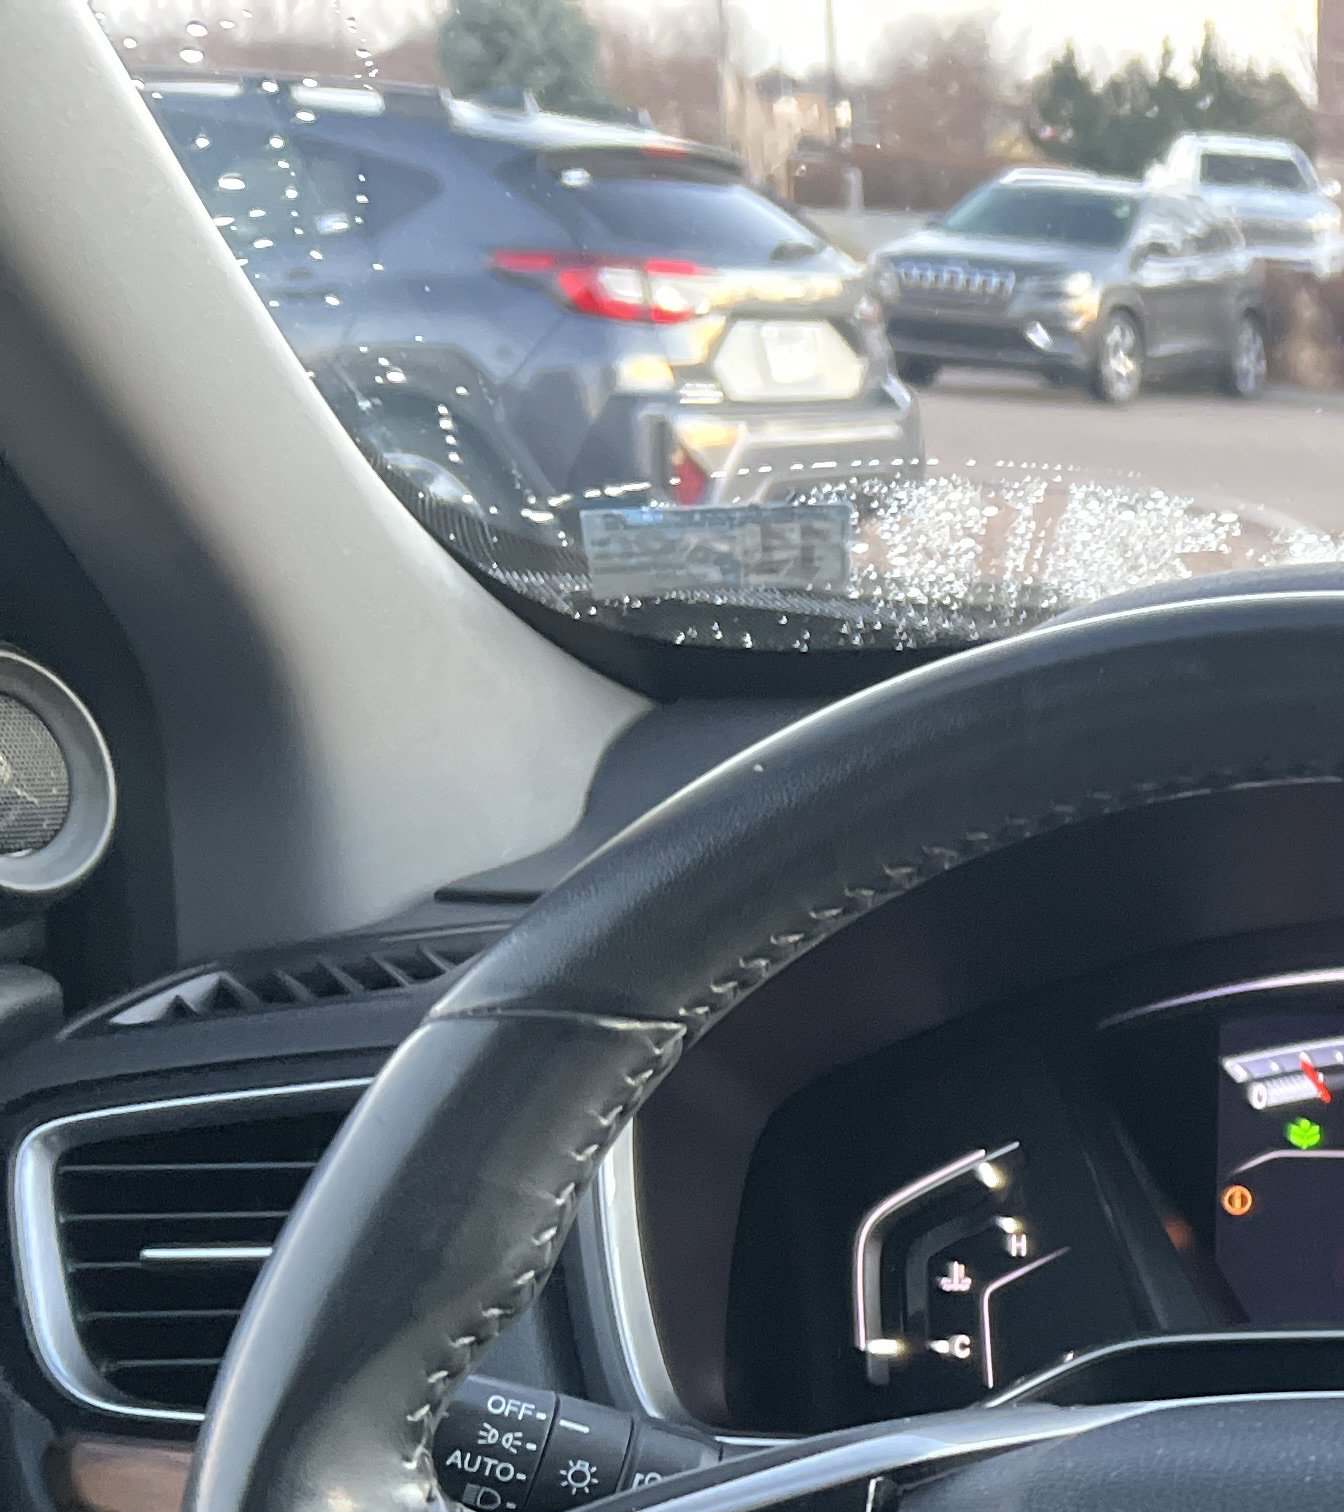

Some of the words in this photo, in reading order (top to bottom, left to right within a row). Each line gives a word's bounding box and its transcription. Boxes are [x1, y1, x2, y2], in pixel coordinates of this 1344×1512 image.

[1009, 1233, 1027, 1257] H
[953, 1334, 971, 1359] C
[487, 1395, 535, 1420] OFF
[446, 1450, 516, 1482] AUTO
